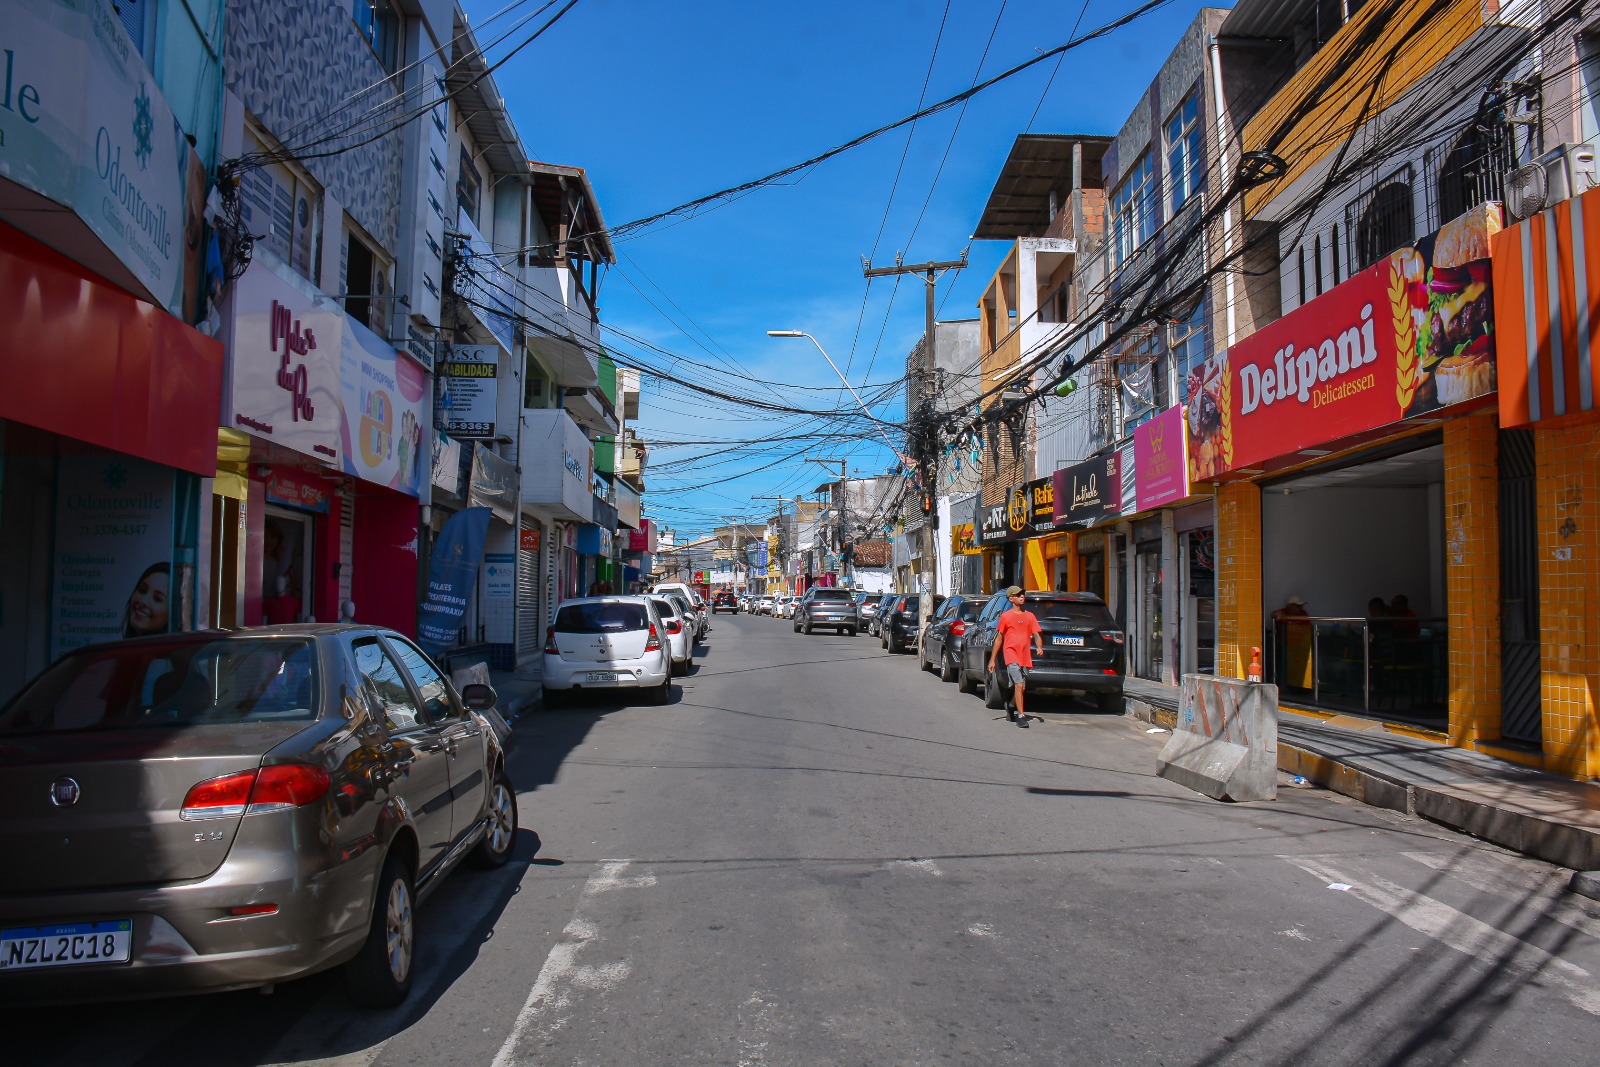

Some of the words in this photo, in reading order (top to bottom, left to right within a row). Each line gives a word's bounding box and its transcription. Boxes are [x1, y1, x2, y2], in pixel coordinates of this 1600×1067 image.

[95, 126, 171, 260] Odontoville
[1239, 303, 1377, 415] Delipani
[1313, 373, 1375, 409] Delicatessen
[66, 492, 163, 510] Odontoville
[80, 526, 90, 536] 71
[93, 524, 148, 536] 3378-4347
[61, 553, 116, 565] Ortodontia
[61, 566, 102, 578] Cirurgia
[61, 581, 105, 593] Implante
[59, 608, 118, 620] Restauração
[60, 624, 121, 634] Clareamento
[56, 784, 74, 800] FIAT
[8, 934, 116, 966] NZL2C18
